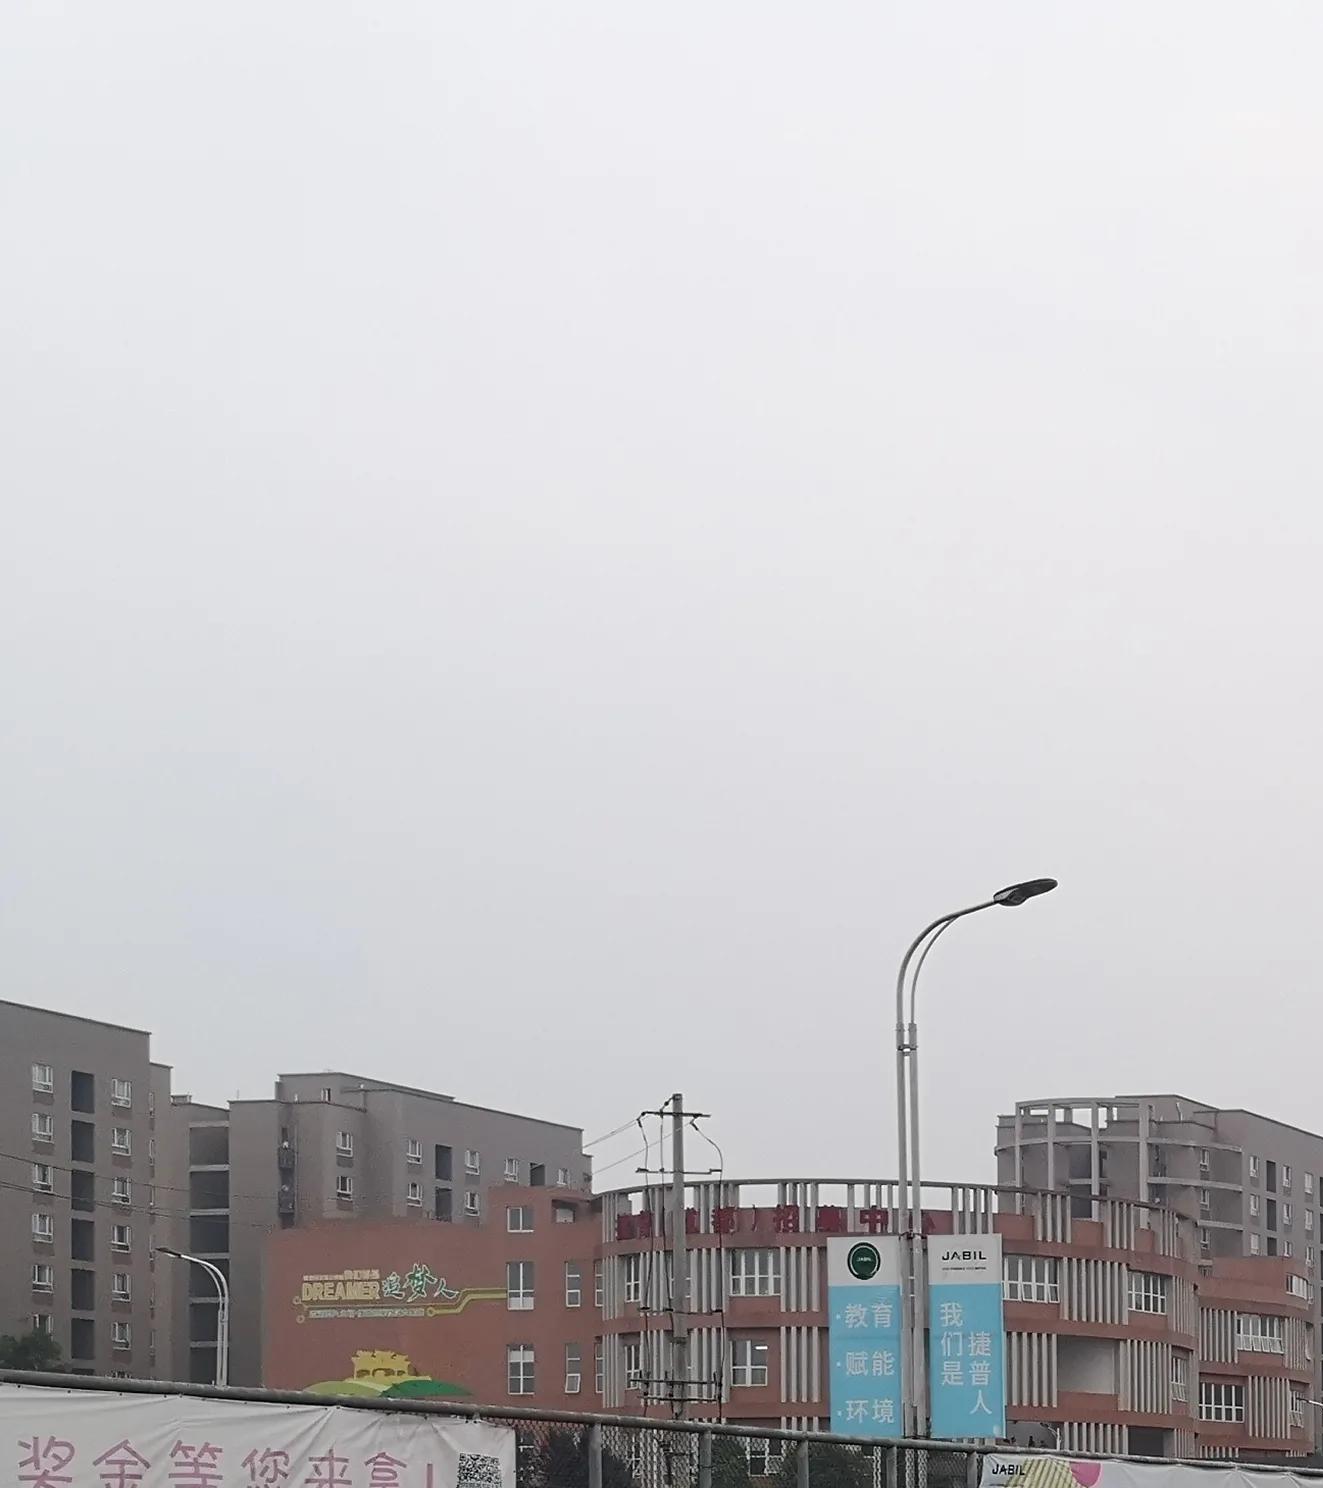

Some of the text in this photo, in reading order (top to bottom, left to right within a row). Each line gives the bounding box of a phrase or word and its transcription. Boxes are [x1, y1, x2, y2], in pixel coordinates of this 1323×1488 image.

[941, 1250, 987, 1261] JABIL
[302, 1281, 381, 1301] DREAMER
[382, 1262, 460, 1303] 追梦人
[844, 1302, 894, 1329] 教育
[940, 1302, 964, 1386] 我们是
[845, 1350, 896, 1377] 赋能
[967, 1330, 993, 1416] 捷普人
[845, 1399, 896, 1424] 环境
[992, 1463, 1026, 1476] JABIL
